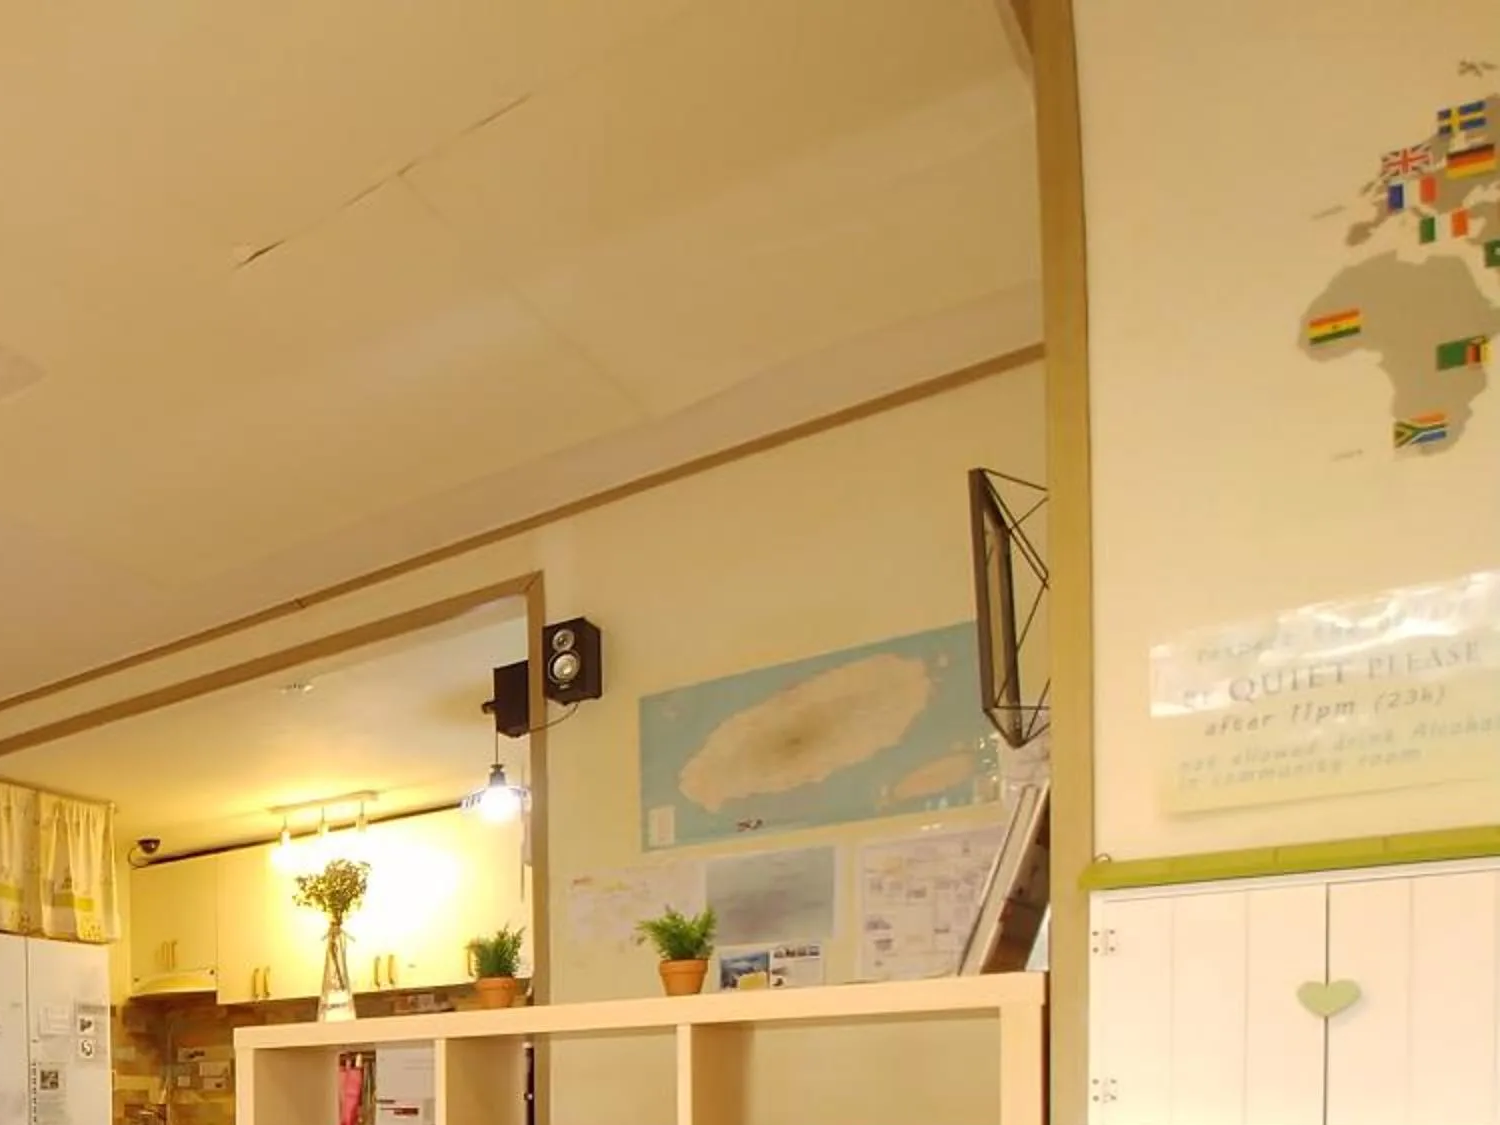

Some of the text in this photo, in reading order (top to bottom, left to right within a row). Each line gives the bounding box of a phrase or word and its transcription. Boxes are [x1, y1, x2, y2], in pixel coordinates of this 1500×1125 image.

[1228, 660, 1351, 704] QUIET
[1367, 640, 1482, 681] PLEASE
[1204, 685, 1446, 736] after 11pm (23h)
